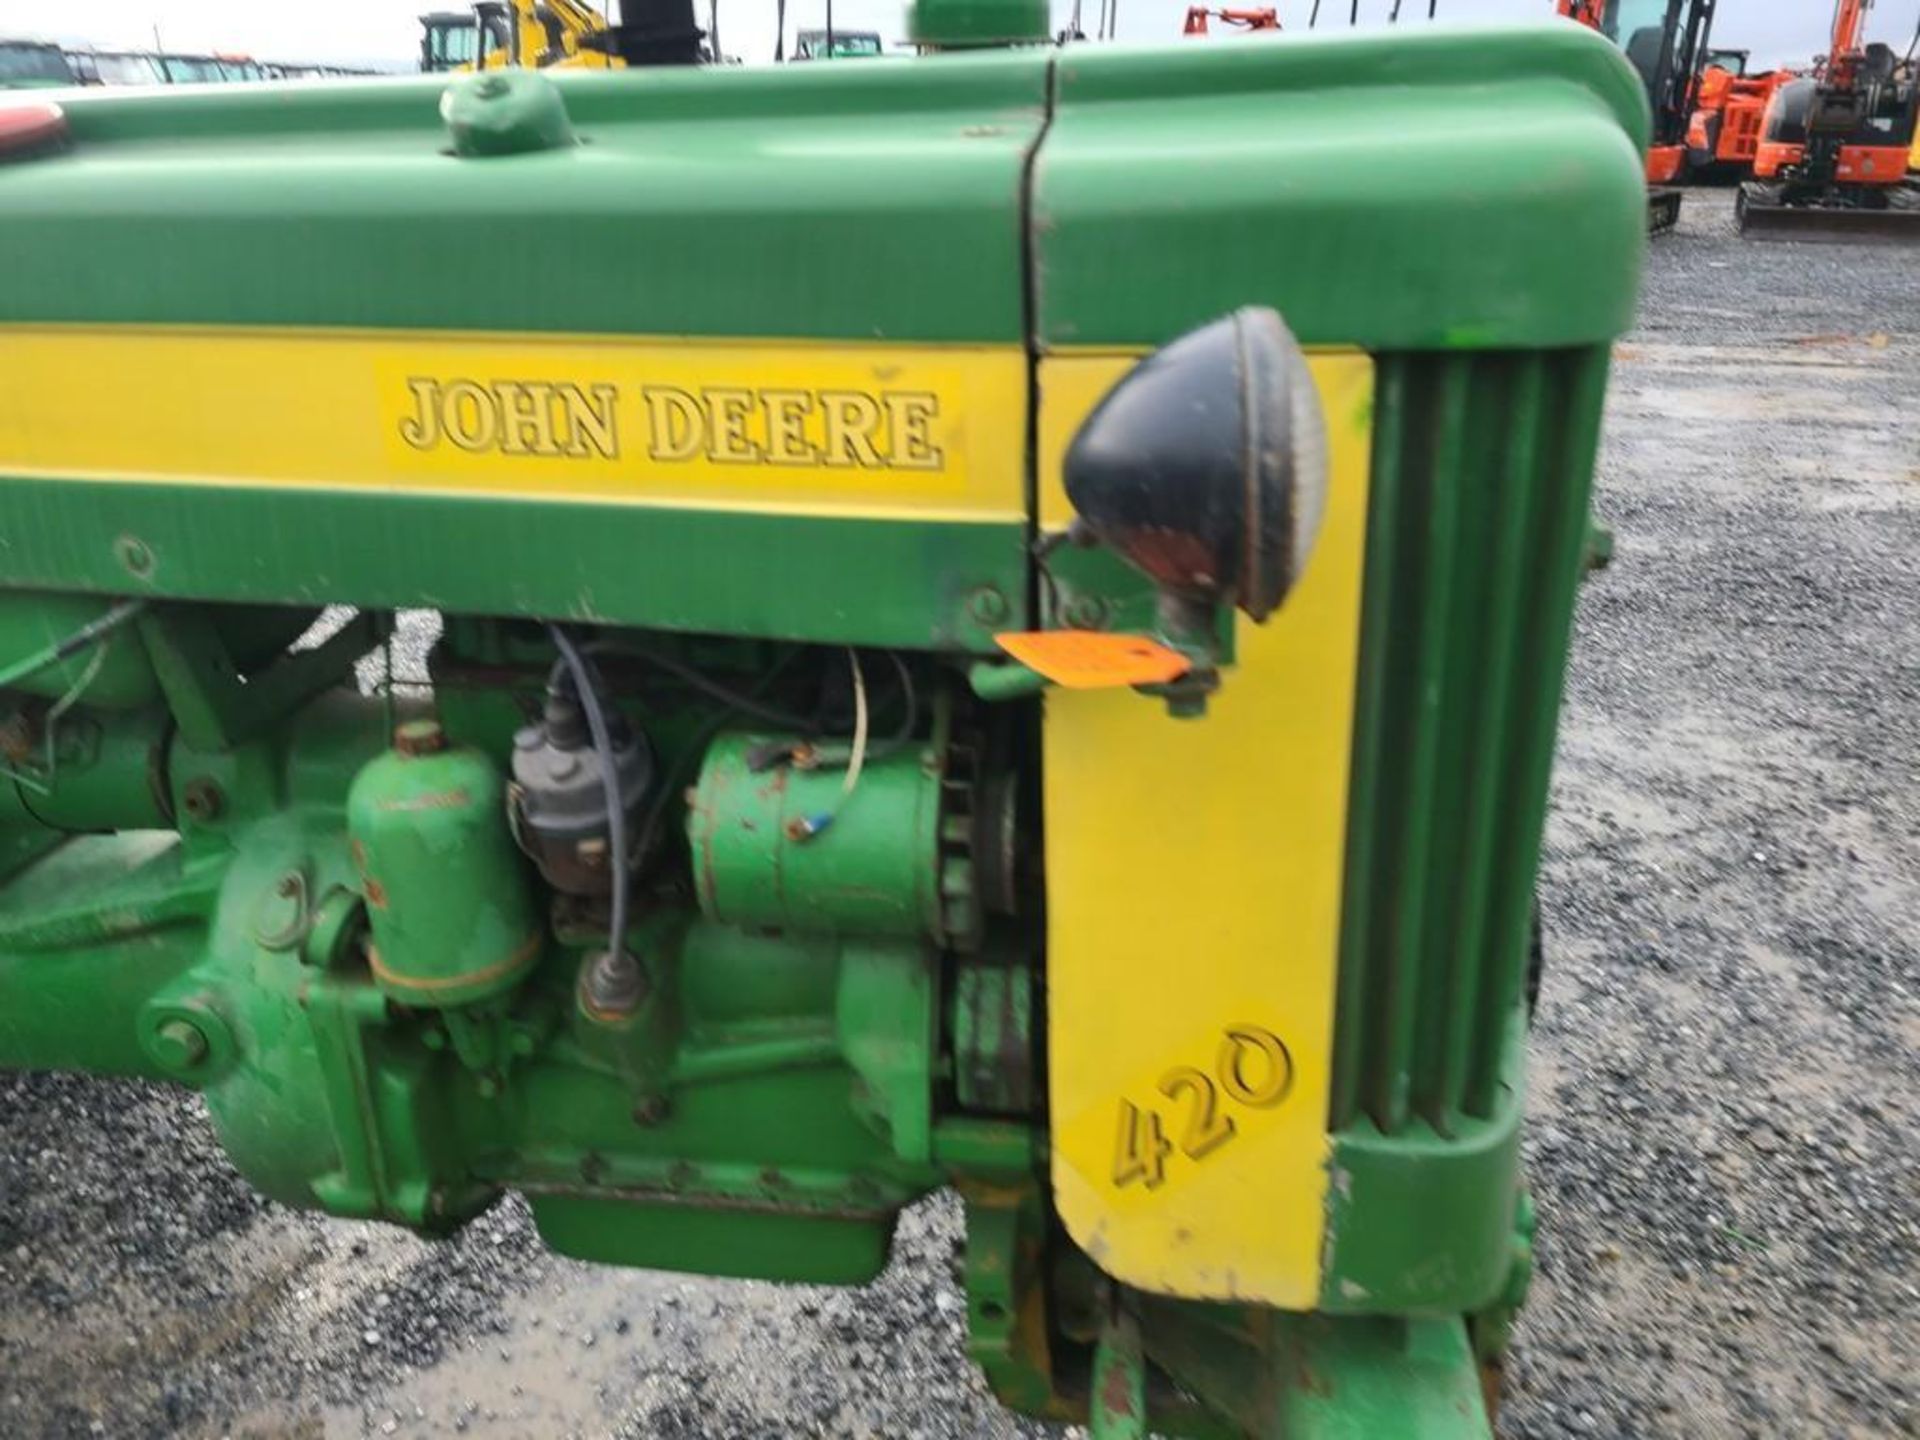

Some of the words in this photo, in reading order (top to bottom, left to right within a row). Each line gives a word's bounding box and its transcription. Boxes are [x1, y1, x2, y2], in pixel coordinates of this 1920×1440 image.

[401, 377, 619, 461] JOHN
[643, 385, 944, 471] DEERE
[1112, 1023, 1294, 1190] 420
